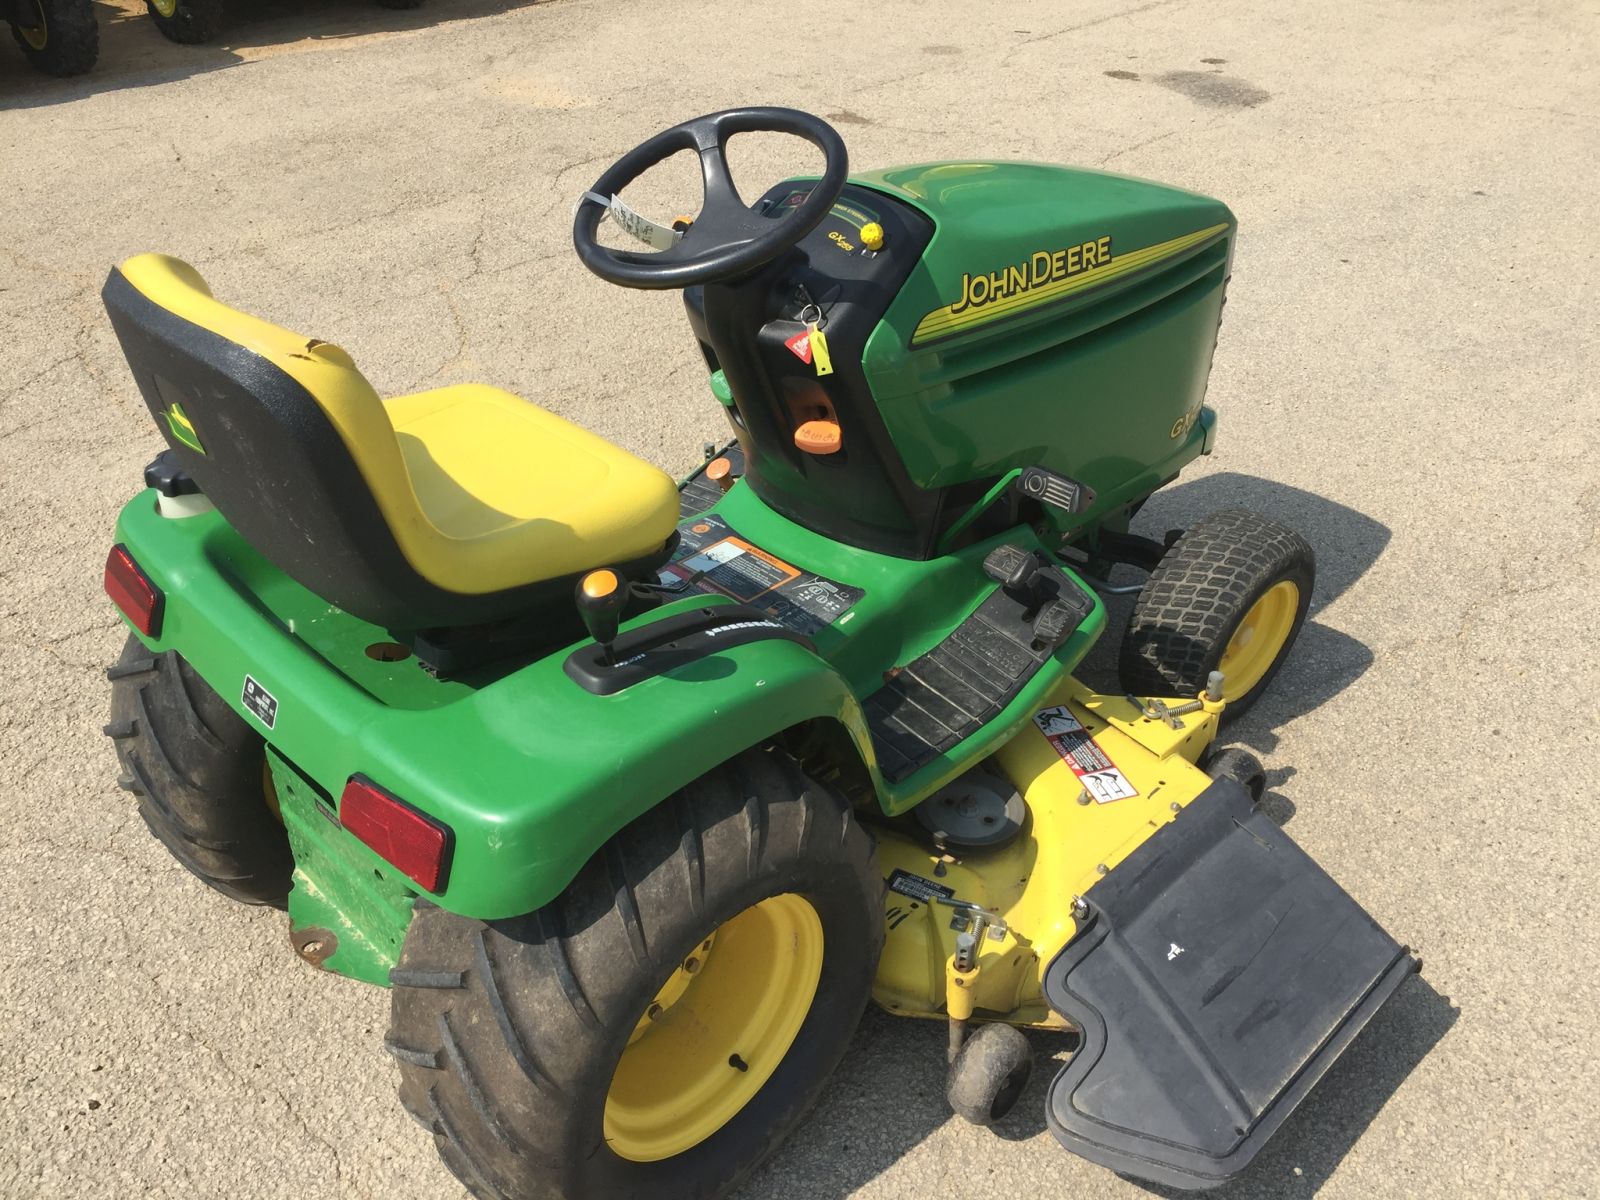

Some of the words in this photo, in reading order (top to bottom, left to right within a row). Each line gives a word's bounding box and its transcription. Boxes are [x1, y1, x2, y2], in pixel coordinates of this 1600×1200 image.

[951, 262, 1029, 314] JOHN
[1031, 235, 1112, 288] DEERE
[1053, 741, 1074, 765] DANGER
